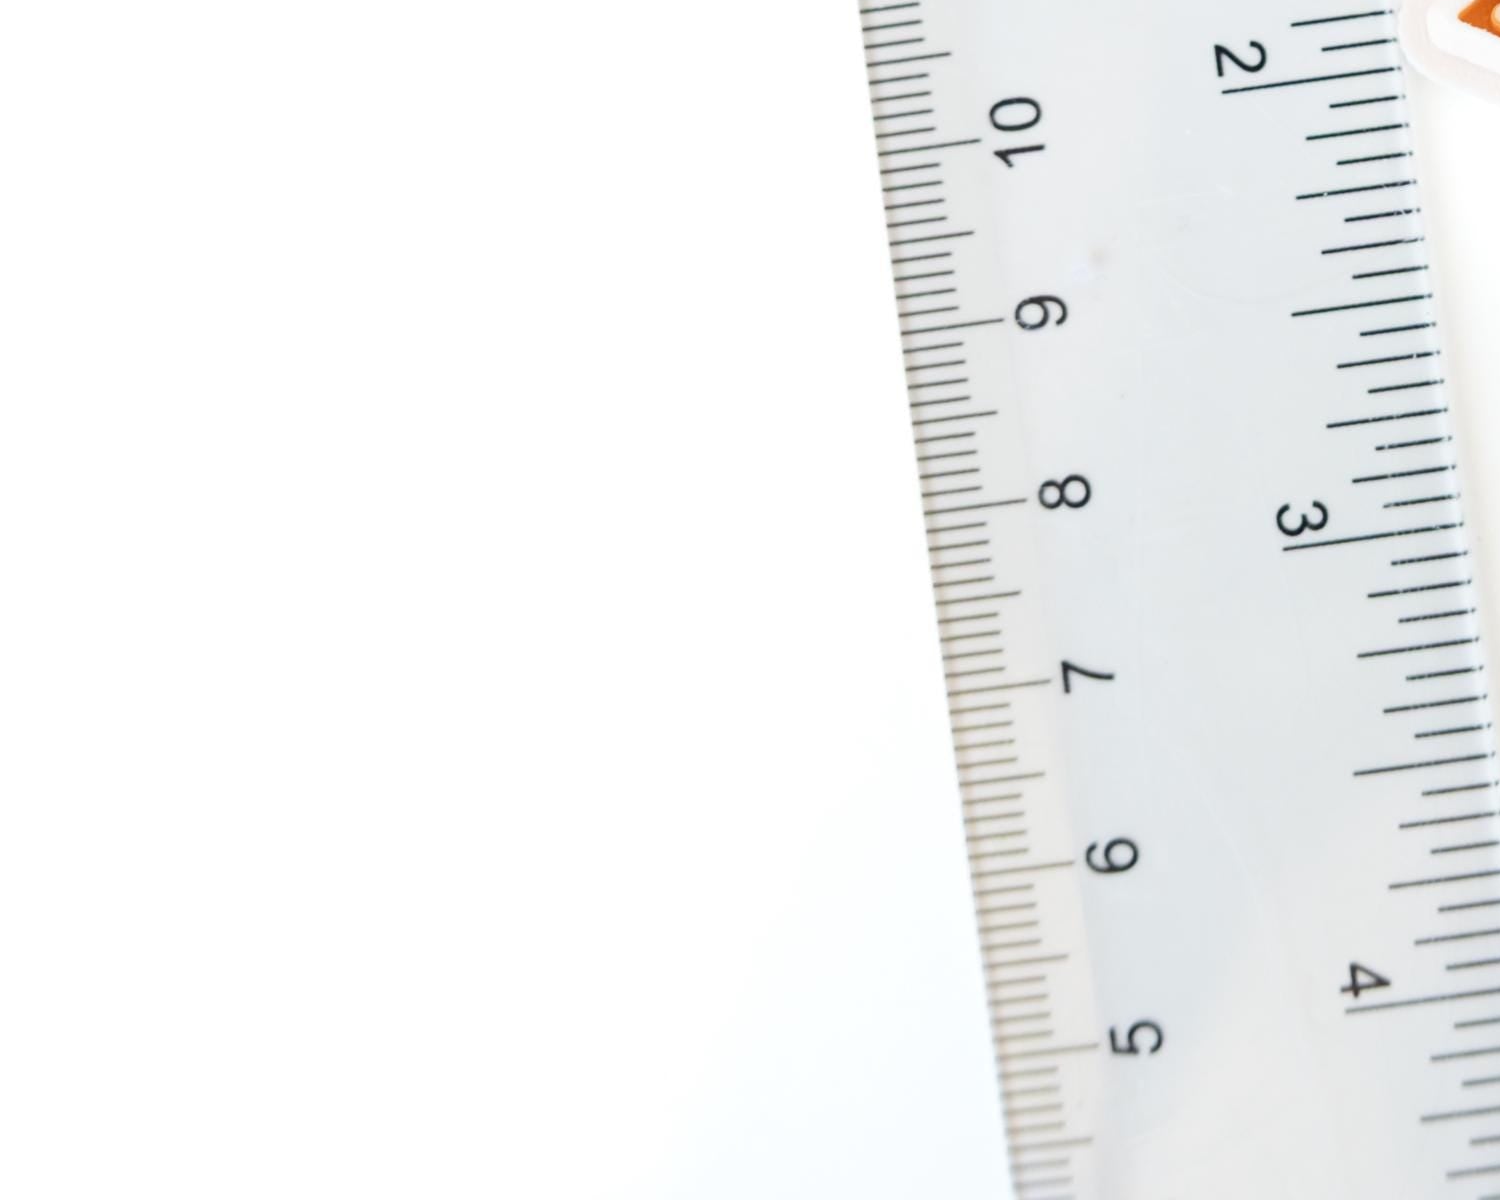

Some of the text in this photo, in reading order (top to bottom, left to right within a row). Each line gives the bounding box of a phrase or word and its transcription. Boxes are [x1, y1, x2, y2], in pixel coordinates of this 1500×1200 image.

[1213, 40, 1268, 78] 2
[988, 96, 1046, 168] 10
[1014, 294, 1069, 332] 9
[1037, 474, 1092, 511] 8
[1275, 500, 1330, 536] 3
[1059, 659, 1116, 695] 7
[1084, 837, 1140, 874] 6
[1339, 961, 1392, 998] 4
[1108, 1019, 1165, 1056] 5
